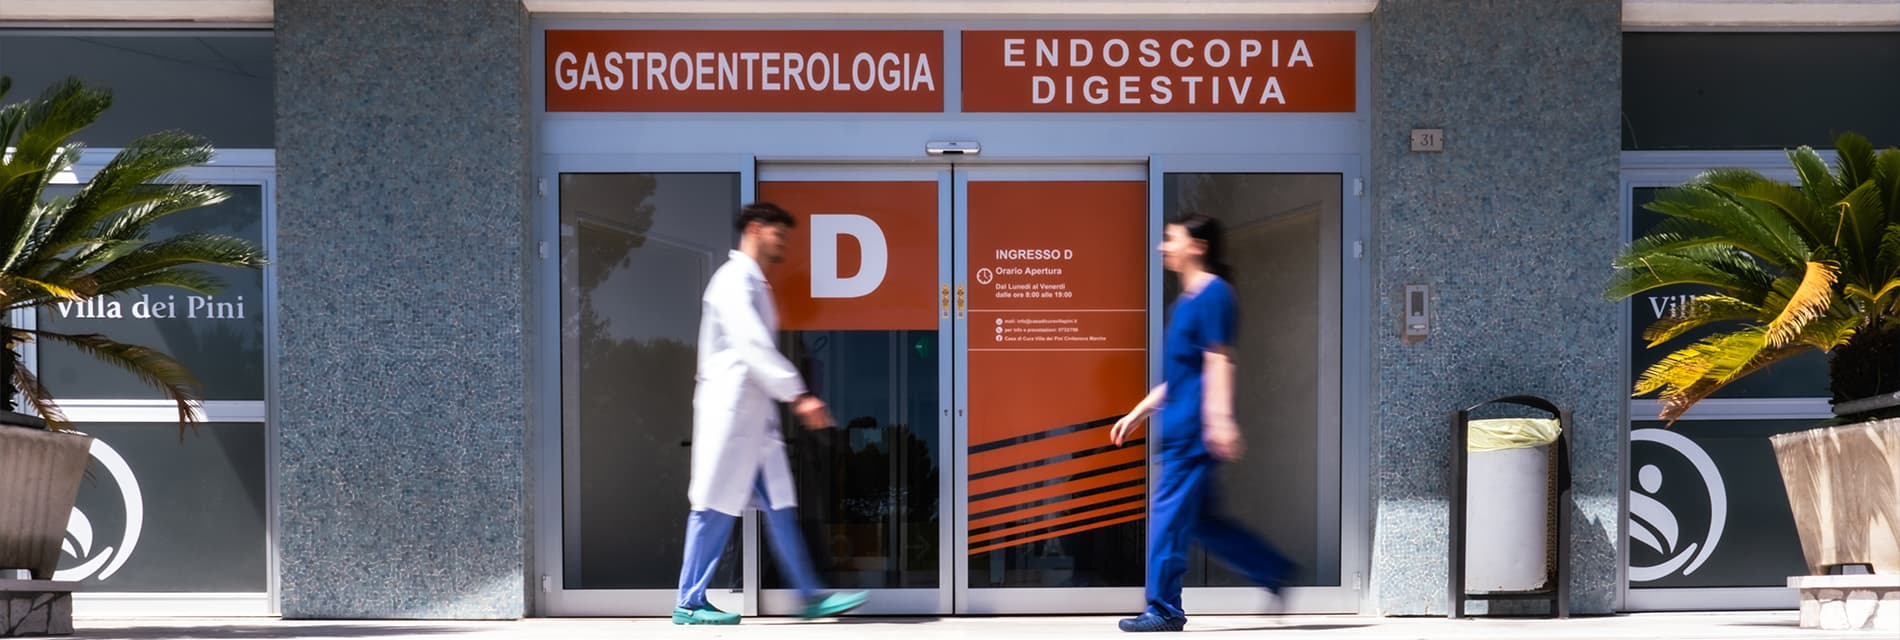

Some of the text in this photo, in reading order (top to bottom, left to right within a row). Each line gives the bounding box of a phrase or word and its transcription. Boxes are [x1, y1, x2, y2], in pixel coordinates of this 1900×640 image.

[1004, 38, 1315, 68] ENDOSCOPIA
[555, 51, 935, 93] GASTROENTEROLOGIA
[1032, 75, 1287, 105] DIGESTIVA
[1420, 133, 1434, 147] 31
[810, 214, 888, 298] D
[995, 249, 1073, 261] INGRESSO D
[995, 266, 1062, 277] Orario Apertura
[132, 294, 176, 319] dei
[186, 295, 246, 319] Pini
